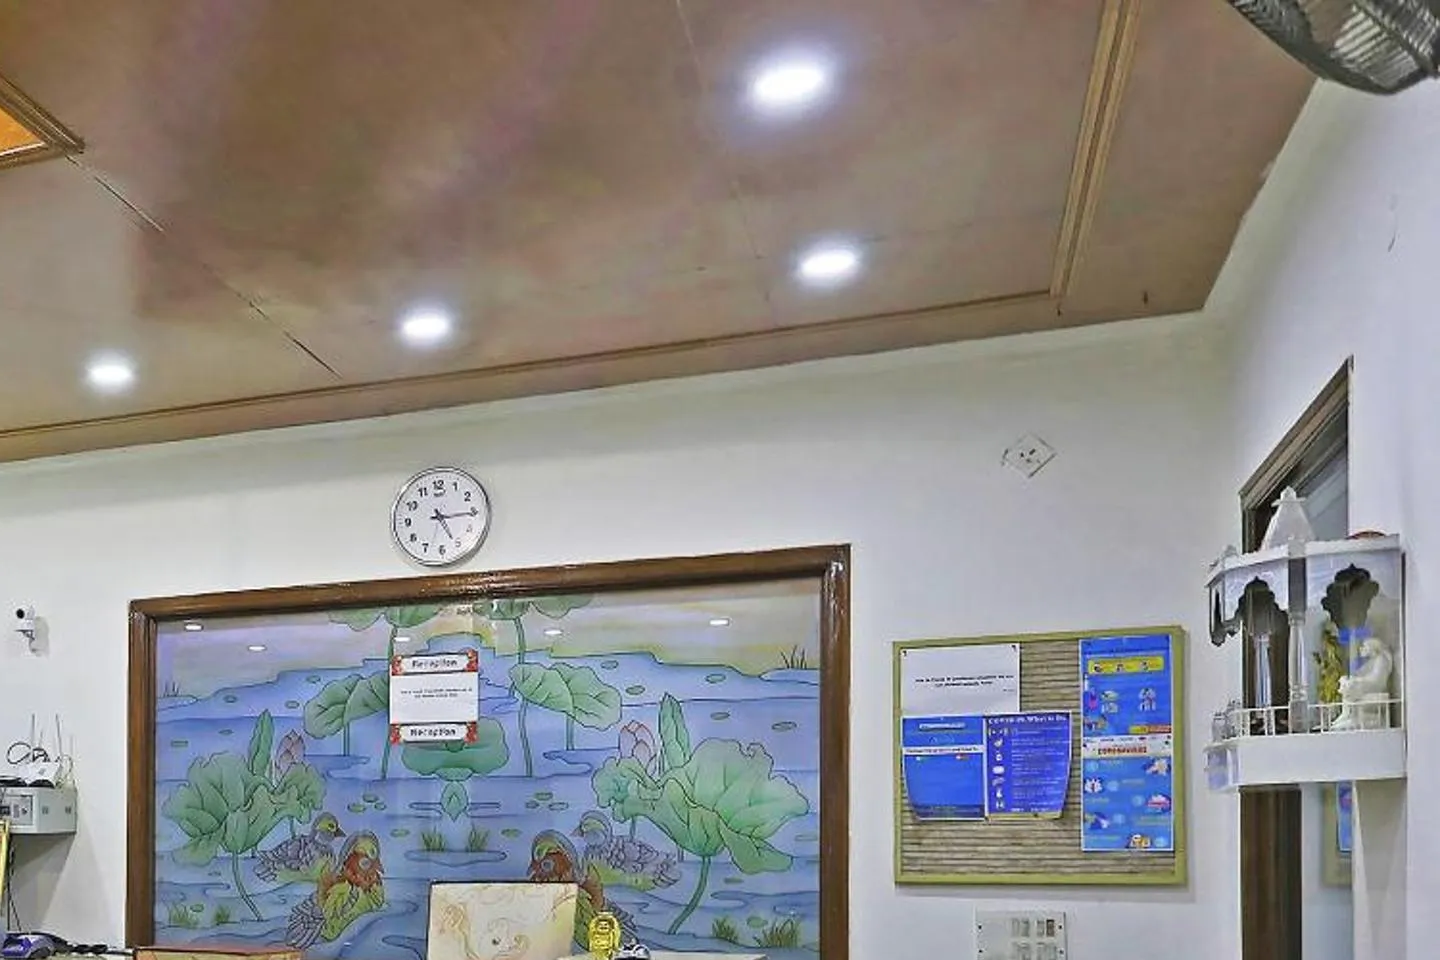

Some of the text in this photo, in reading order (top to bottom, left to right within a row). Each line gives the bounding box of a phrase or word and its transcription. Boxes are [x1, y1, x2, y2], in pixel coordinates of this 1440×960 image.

[432, 480, 444, 490] 12
[417, 487, 428, 497] 11
[464, 491, 471, 502] 2
[406, 500, 418, 511] 10
[410, 727, 457, 738] Reception
